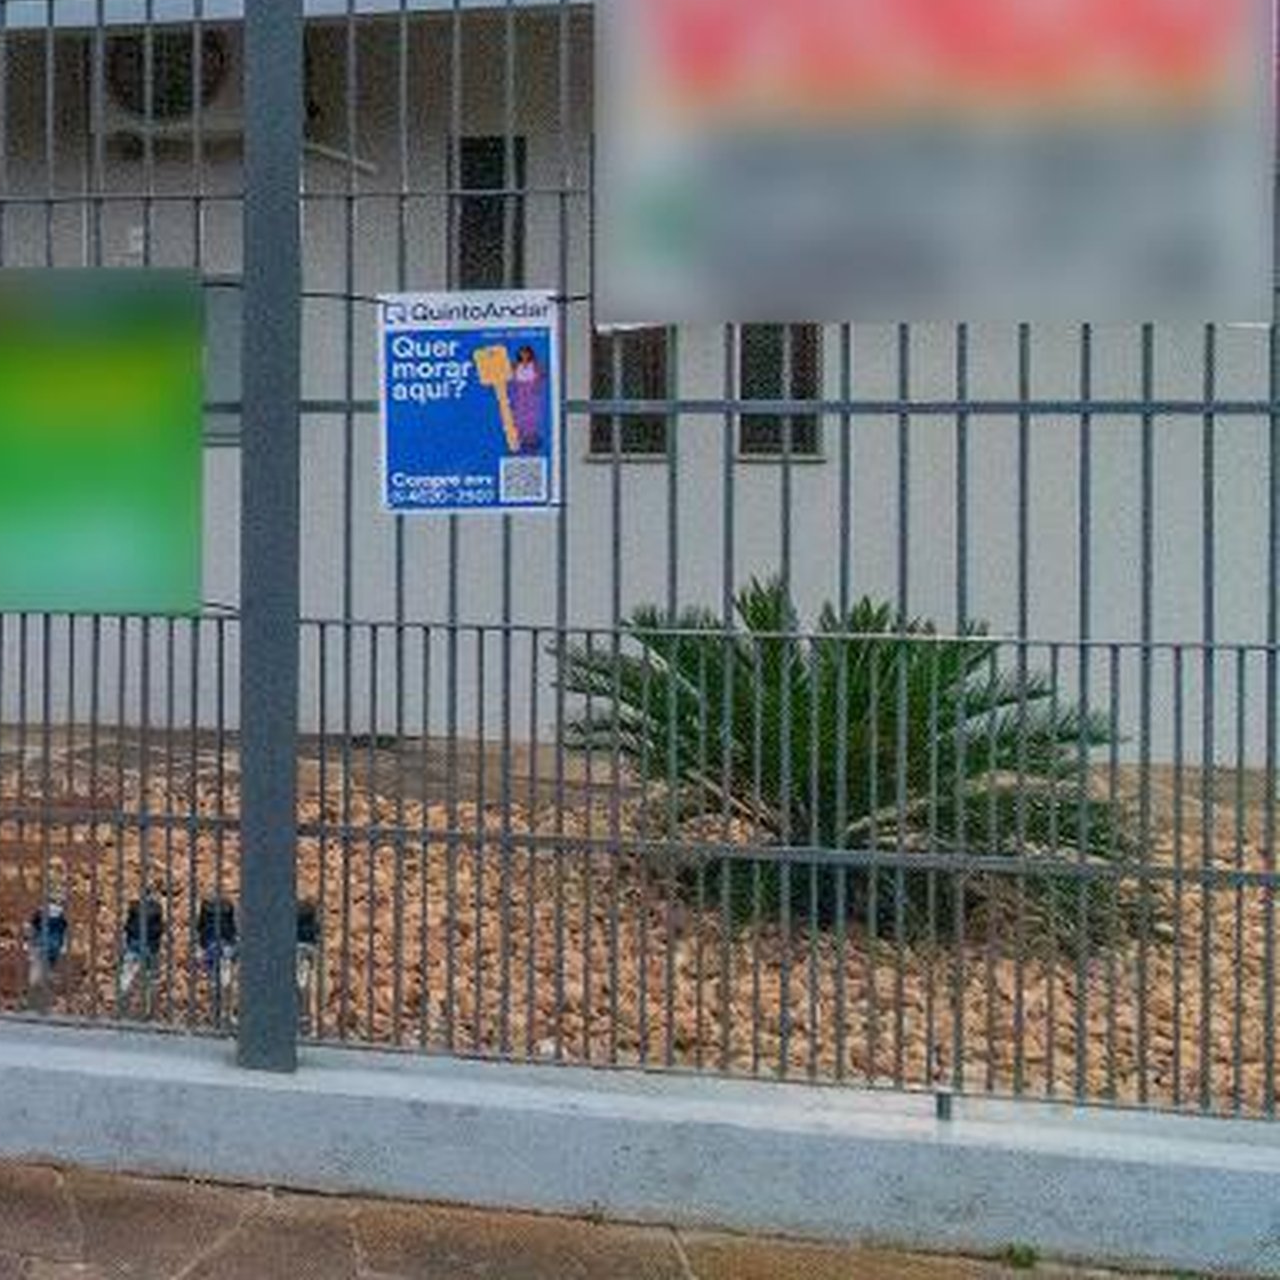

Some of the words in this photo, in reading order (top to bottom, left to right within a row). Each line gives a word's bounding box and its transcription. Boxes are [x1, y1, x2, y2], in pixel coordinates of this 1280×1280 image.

[411, 302, 549, 321] QuintoAndar
[392, 336, 460, 358] Quer
[393, 360, 474, 378] morar
[392, 379, 468, 404] aqui?
